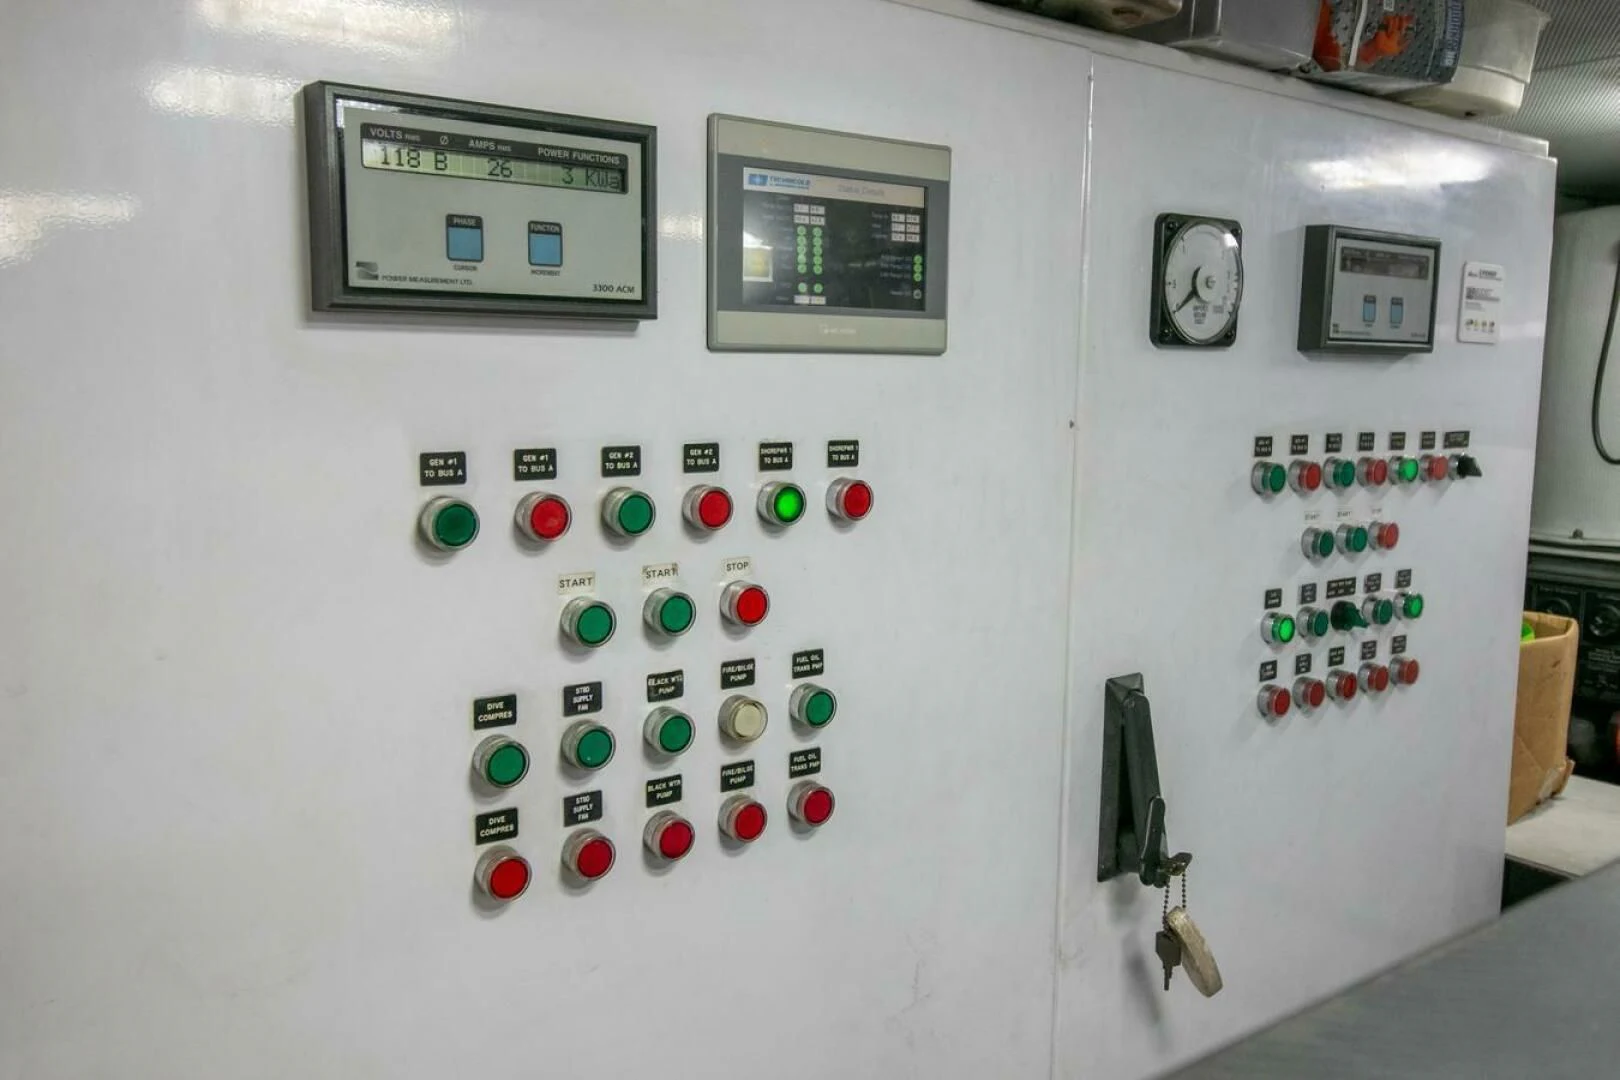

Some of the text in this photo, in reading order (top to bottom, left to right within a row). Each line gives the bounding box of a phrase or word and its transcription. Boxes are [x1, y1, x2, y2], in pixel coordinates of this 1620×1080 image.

[369, 127, 403, 139] VOLTS
[468, 139, 496, 151] AMPS
[538, 147, 569, 158] POWER
[572, 152, 620, 165] FUNCTIONS
[382, 146, 421, 168] 118
[434, 150, 448, 171] B
[488, 156, 513, 178] 26
[561, 165, 574, 184] 3
[453, 216, 477, 227] PHASE
[530, 223, 560, 233] FUNCTION
[382, 274, 407, 282] POWER
[408, 275, 458, 285] MEASUREMENT
[592, 283, 635, 294] 3300 ACM
[624, 451, 634, 459] #2
[704, 448, 713, 456] #2
[429, 457, 457, 467] GEN #1
[522, 454, 549, 462] GEN #1
[686, 457, 717, 466] TO BUS A
[518, 464, 554, 473] TO BUS A
[605, 461, 638, 470] TO BUS A
[424, 469, 463, 478] TO BUS A
[726, 561, 749, 572] STOP
[646, 567, 677, 580] START
[559, 577, 593, 589] START
[796, 655, 809, 663] FUEL
[722, 663, 754, 674] FIRE/BILGE
[793, 664, 810, 673] TRANS
[648, 677, 669, 686] BLACK
[730, 674, 747, 682] PUMP
[575, 686, 590, 694] STBD
[658, 686, 675, 695] PUMP
[573, 694, 593, 704] SUPPLY
[487, 701, 504, 710] DIVE
[478, 711, 513, 722] COMPRES
[793, 752, 817, 763] FUEL OIL
[722, 765, 753, 776] FIRE/BILGE
[791, 762, 808, 772] TRANS
[729, 776, 746, 785] PUMP
[648, 779, 681, 793] BLACK WTR
[575, 795, 590, 804] STBD
[656, 791, 673, 799] PUMP
[573, 804, 593, 814] SUPPLY
[488, 816, 506, 825] DIVE
[480, 826, 515, 837] COMPRES
